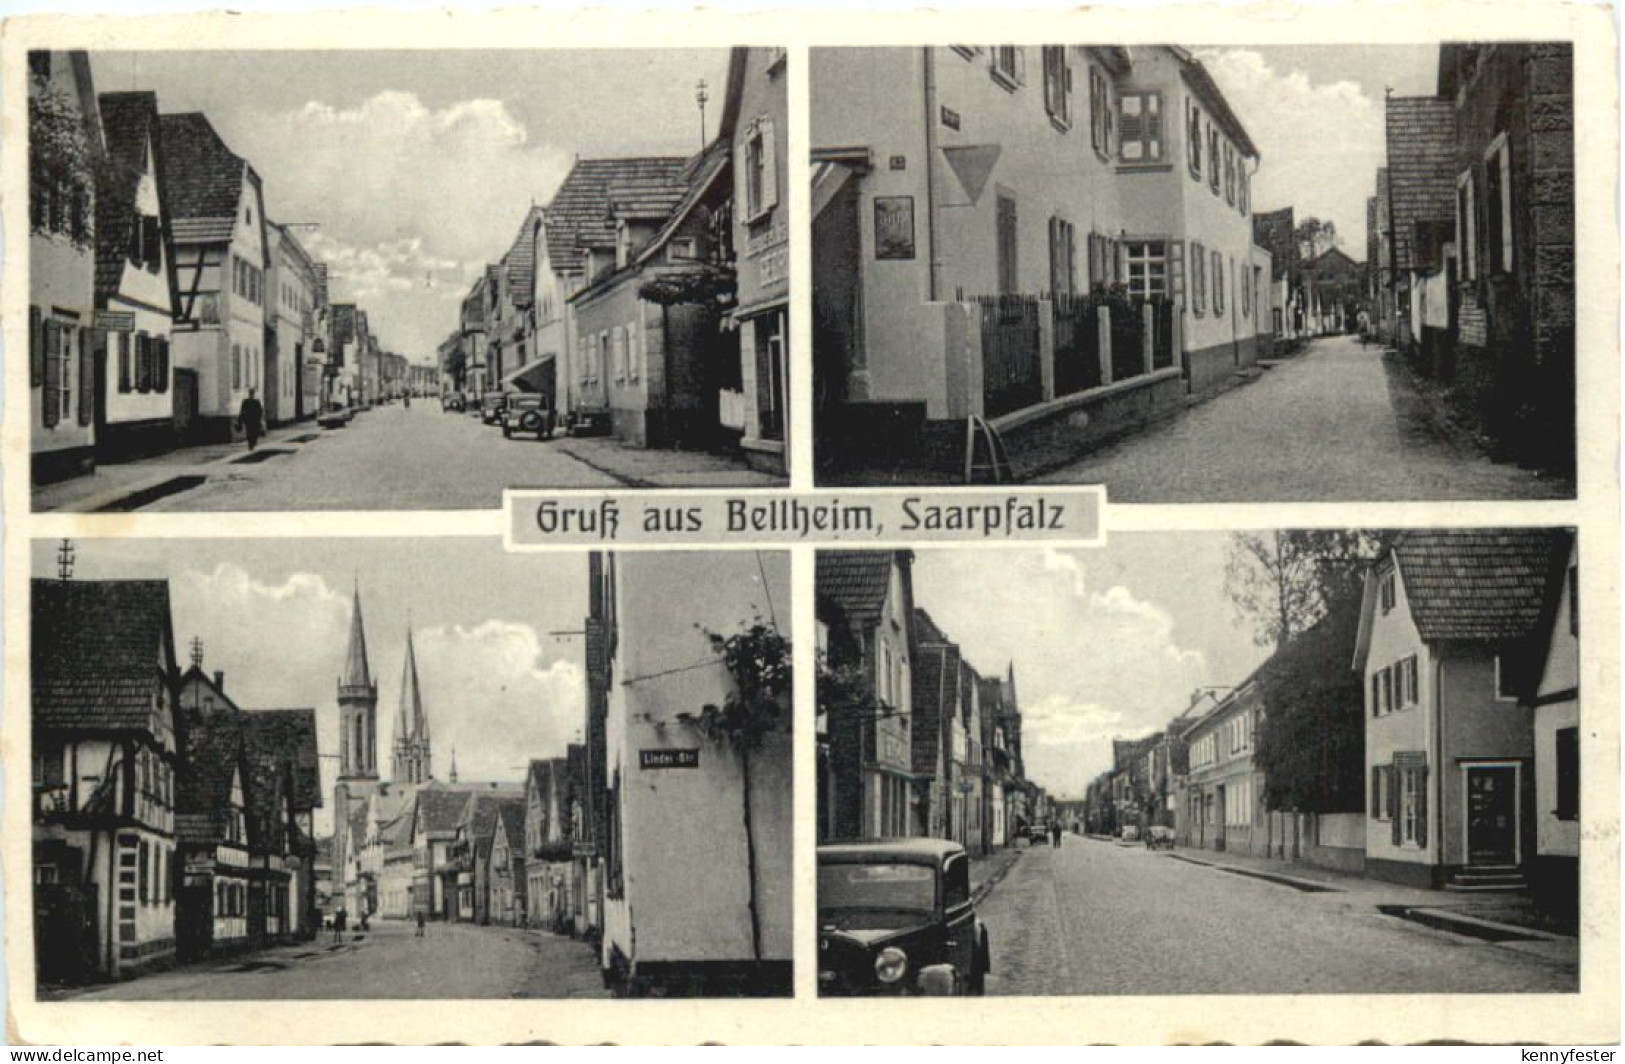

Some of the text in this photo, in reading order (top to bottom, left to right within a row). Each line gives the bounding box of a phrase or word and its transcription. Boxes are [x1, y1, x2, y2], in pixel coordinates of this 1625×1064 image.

[536, 496, 1064, 539] Gruß aus Bellheim, Saarpfalz
